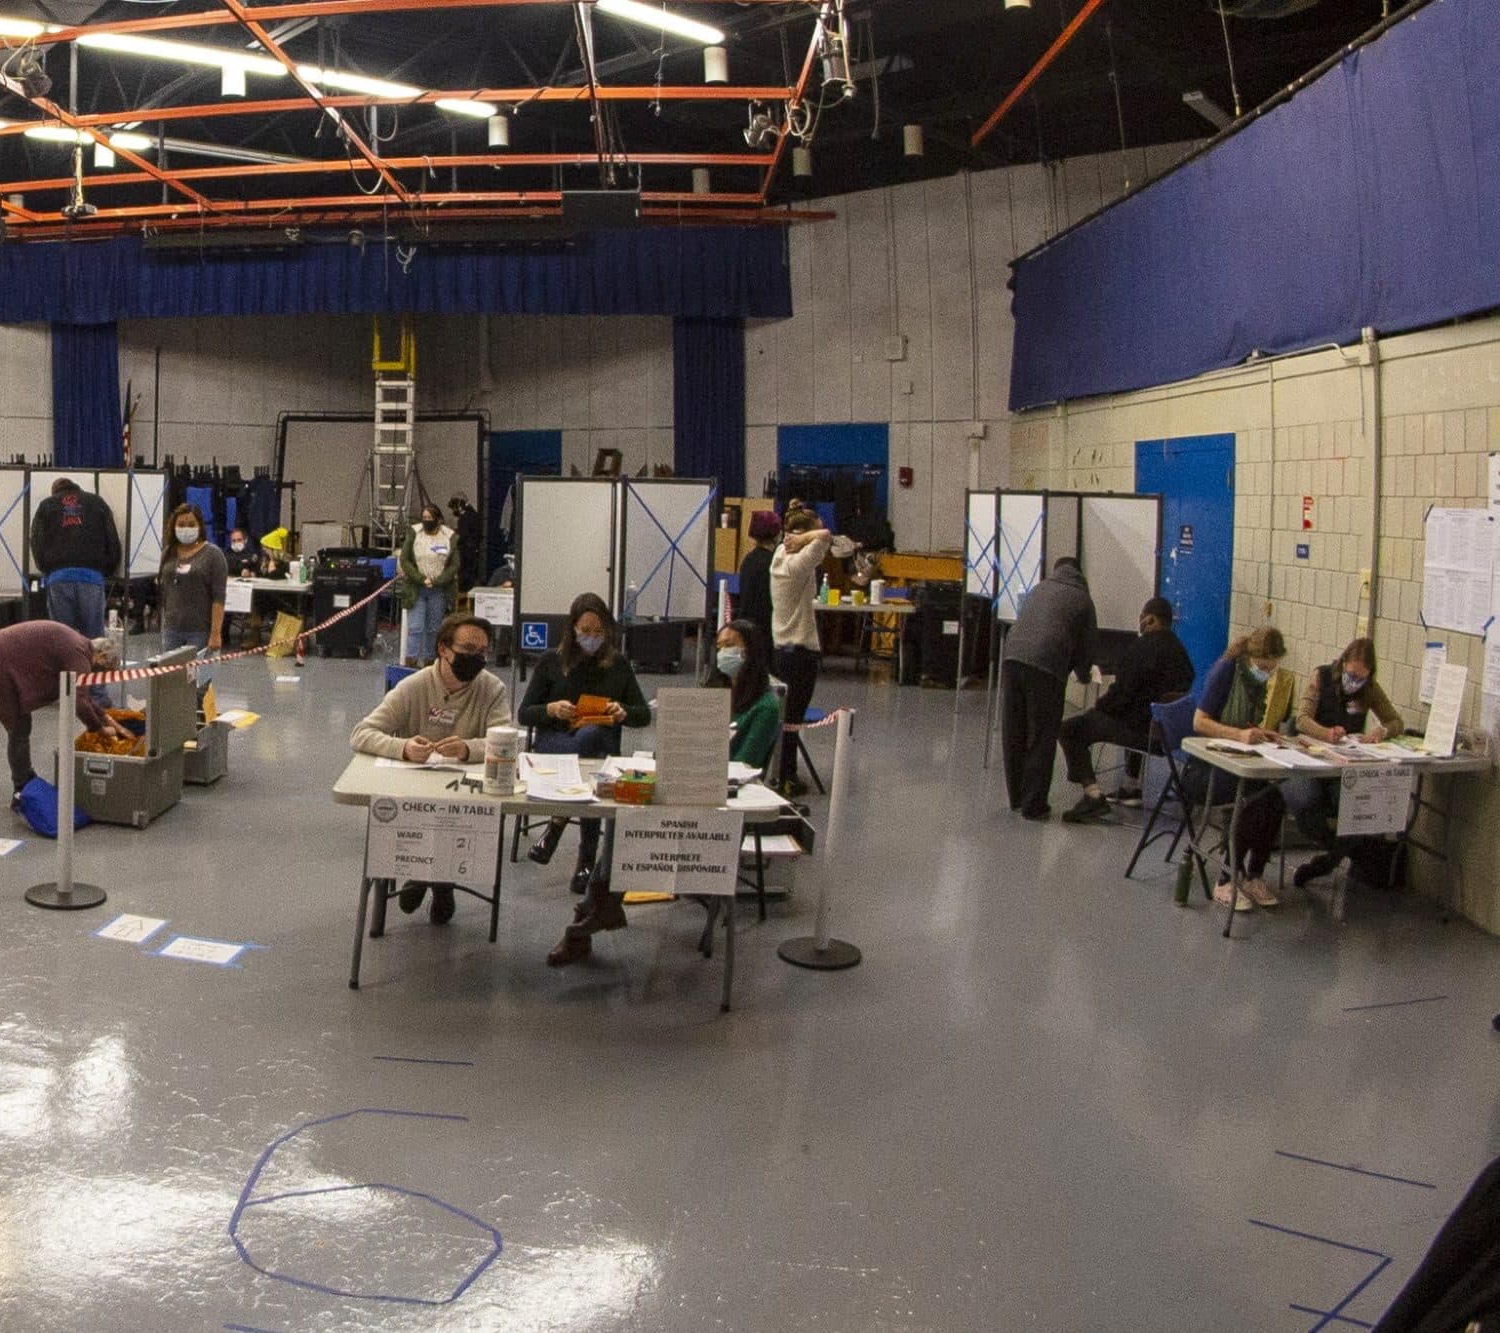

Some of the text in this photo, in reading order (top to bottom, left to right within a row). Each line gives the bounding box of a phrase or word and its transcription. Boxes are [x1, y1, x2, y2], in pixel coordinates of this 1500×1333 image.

[402, 802, 437, 813] CHECK
[448, 804, 460, 814] IN
[464, 805, 495, 816] TABLE
[660, 820, 698, 829] SPANISH
[396, 831, 423, 840] WARD
[625, 830, 730, 841] INTERPRETER AVAILABLE
[395, 854, 434, 864] PRECINCT
[458, 861, 467, 874] 6
[621, 862, 727, 874] EN ESPAÑOL DISPONIBLE
